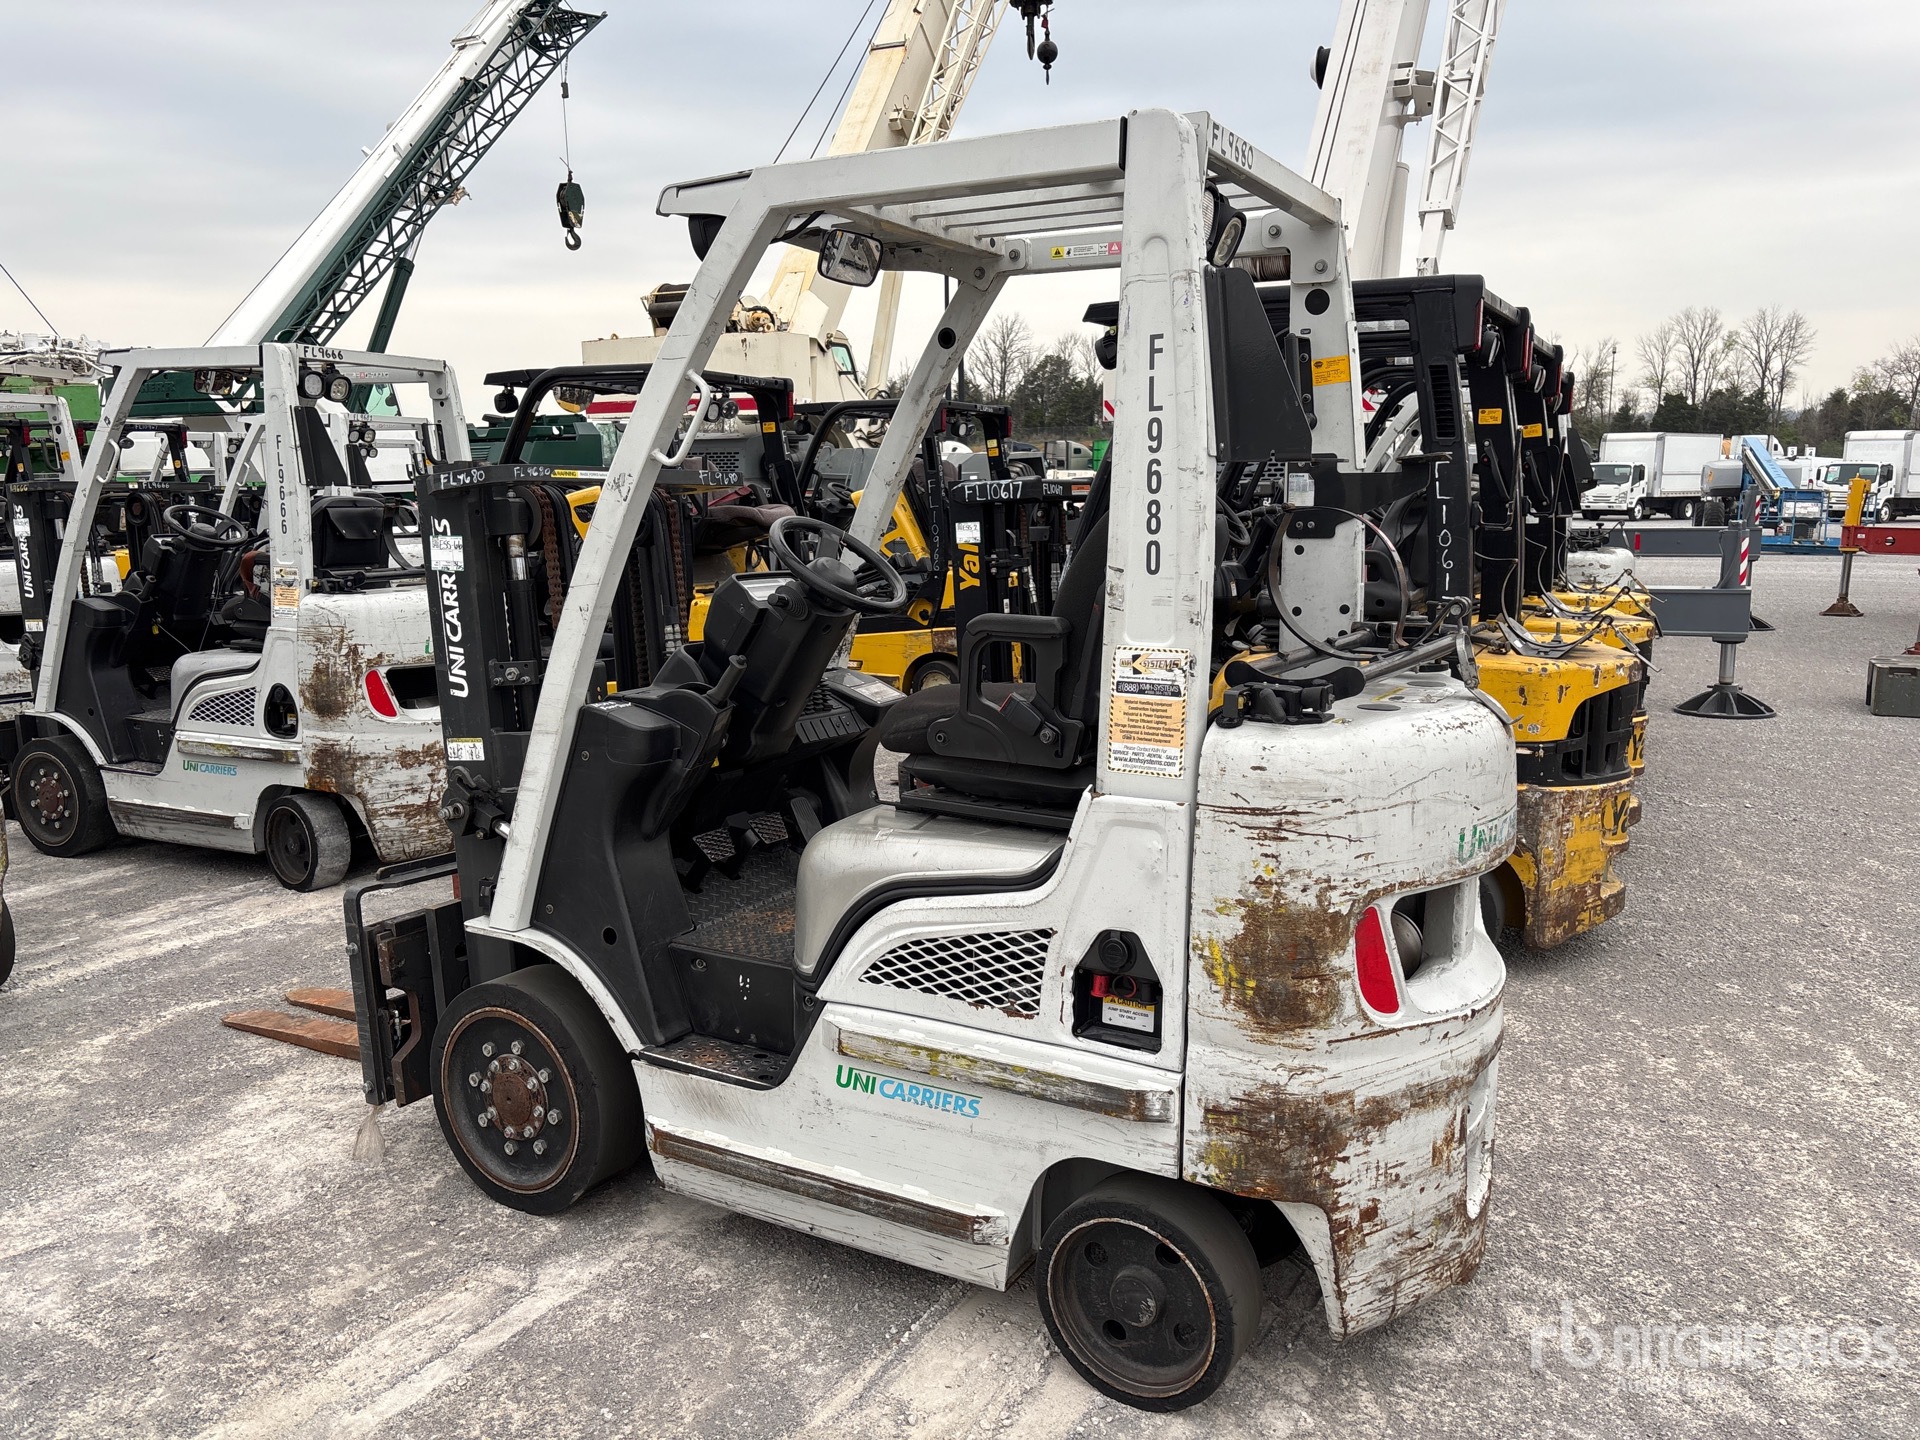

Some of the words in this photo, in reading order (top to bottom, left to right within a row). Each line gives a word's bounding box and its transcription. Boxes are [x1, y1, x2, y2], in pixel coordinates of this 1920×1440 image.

[1211, 120, 1254, 170] FL9680
[303, 345, 344, 360] FL9666
[513, 466, 551, 479] FL9680
[1145, 332, 1165, 576] FL9680
[275, 434, 288, 534] FL9666
[964, 480, 1023, 503] FL10617
[1434, 460, 1455, 600] FL1061
[957, 542, 981, 592] Yal
[434, 517, 470, 699] UNICARRS
[182, 759, 238, 777] UNICARRIERS
[835, 1064, 983, 1119] UNICARRIERS
